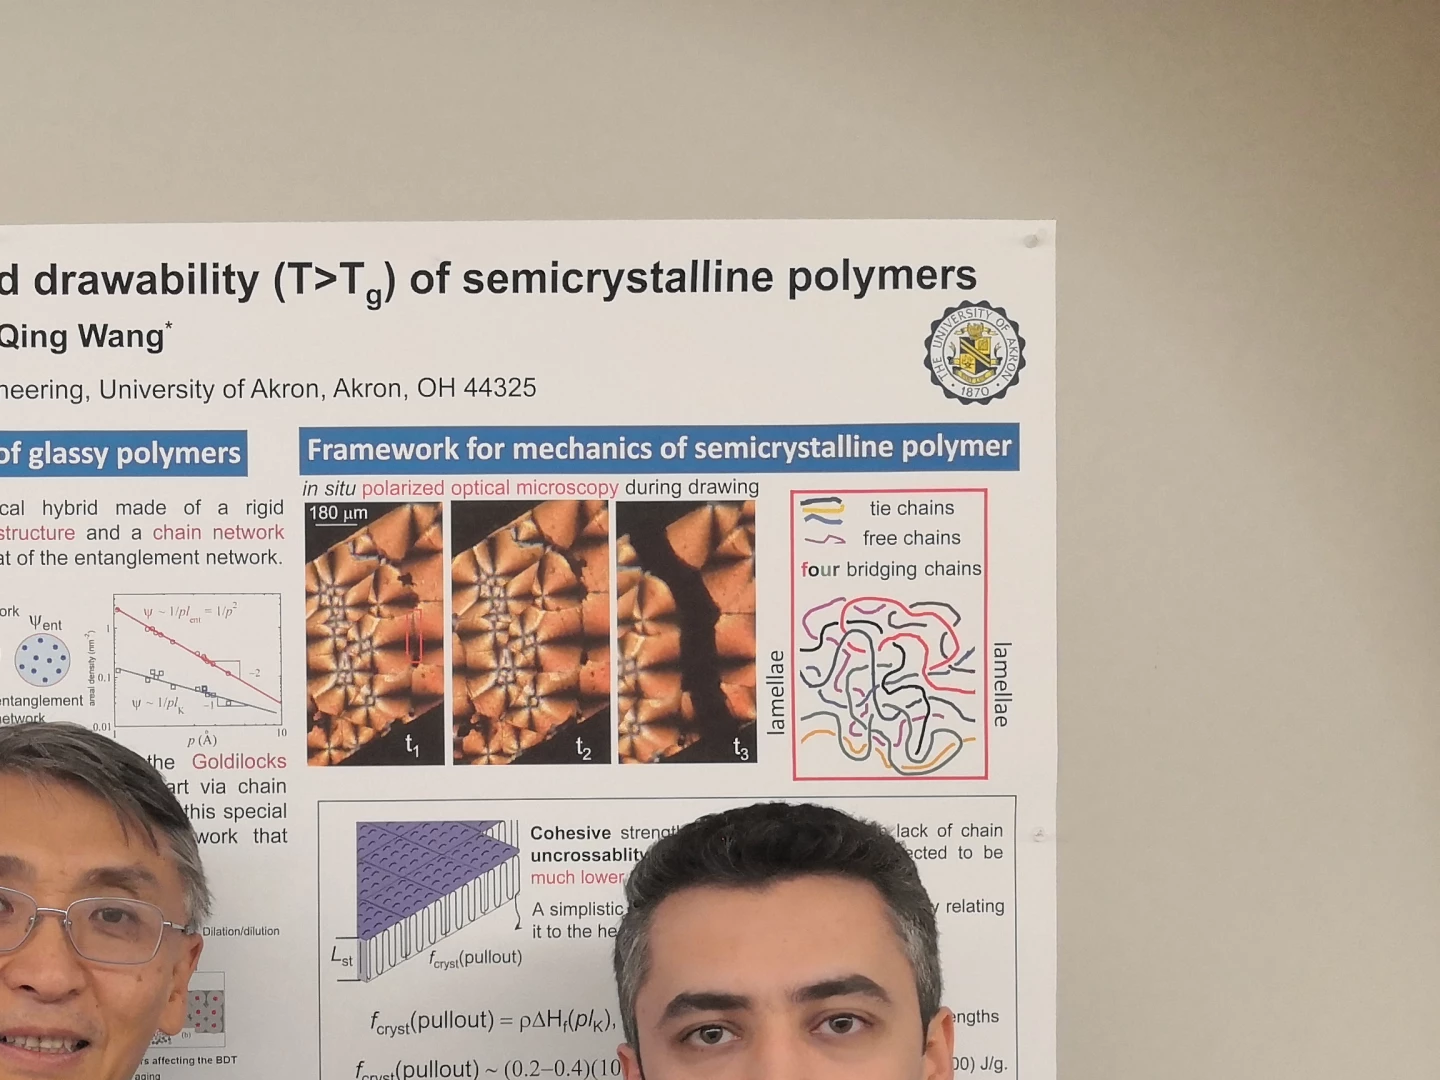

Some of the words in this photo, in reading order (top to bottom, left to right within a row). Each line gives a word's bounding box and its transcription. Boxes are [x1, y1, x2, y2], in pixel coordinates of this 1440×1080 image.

[33, 261, 260, 303] drawability
[409, 259, 452, 295] of
[462, 258, 773, 302] semicrystalline
[789, 257, 977, 300] polymers
[932, 308, 993, 349] UNIVERSITY
[995, 318, 1010, 331] OF
[932, 356, 948, 382] THE
[1001, 337, 1018, 381] AKRON
[99, 377, 215, 404] University
[222, 377, 246, 399] of
[249, 377, 325, 402] Akron,
[332, 377, 408, 401] Akron,
[417, 376, 455, 398] OH
[463, 376, 536, 397] 44325
[961, 386, 989, 397] 1870
[27, 439, 109, 470] glassy
[116, 439, 241, 469] polymers
[307, 435, 459, 461] Framework
[465, 435, 505, 460] for
[512, 434, 652, 460] mechanics
[659, 434, 688, 459] of
[694, 433, 894, 464] semicrystalline
[901, 432, 1013, 463] polymer
[301, 479, 318, 496] in
[323, 479, 356, 496] situ
[362, 478, 444, 500] polarized
[450, 478, 509, 501] optical
[516, 478, 619, 501] microscopy
[624, 477, 681, 499] during
[687, 477, 759, 501] drawing
[309, 504, 339, 520] 180
[869, 499, 891, 516] tie
[896, 498, 955, 515] chains
[85, 523, 120, 540] and
[130, 527, 141, 540] a
[152, 523, 201, 540] chain
[212, 523, 285, 540] network
[862, 529, 897, 546] free
[903, 528, 961, 545] chains
[800, 560, 840, 577] four
[846, 559, 917, 581] bridging
[923, 559, 982, 576] chains
[766, 650, 785, 735] lamellae
[993, 642, 1013, 727] lamellae
[202, 926, 281, 937] Dilation/dilution
[151, 1055, 195, 1067] affecting
[197, 1055, 213, 1065] the
[215, 1055, 237, 1064] BDT
